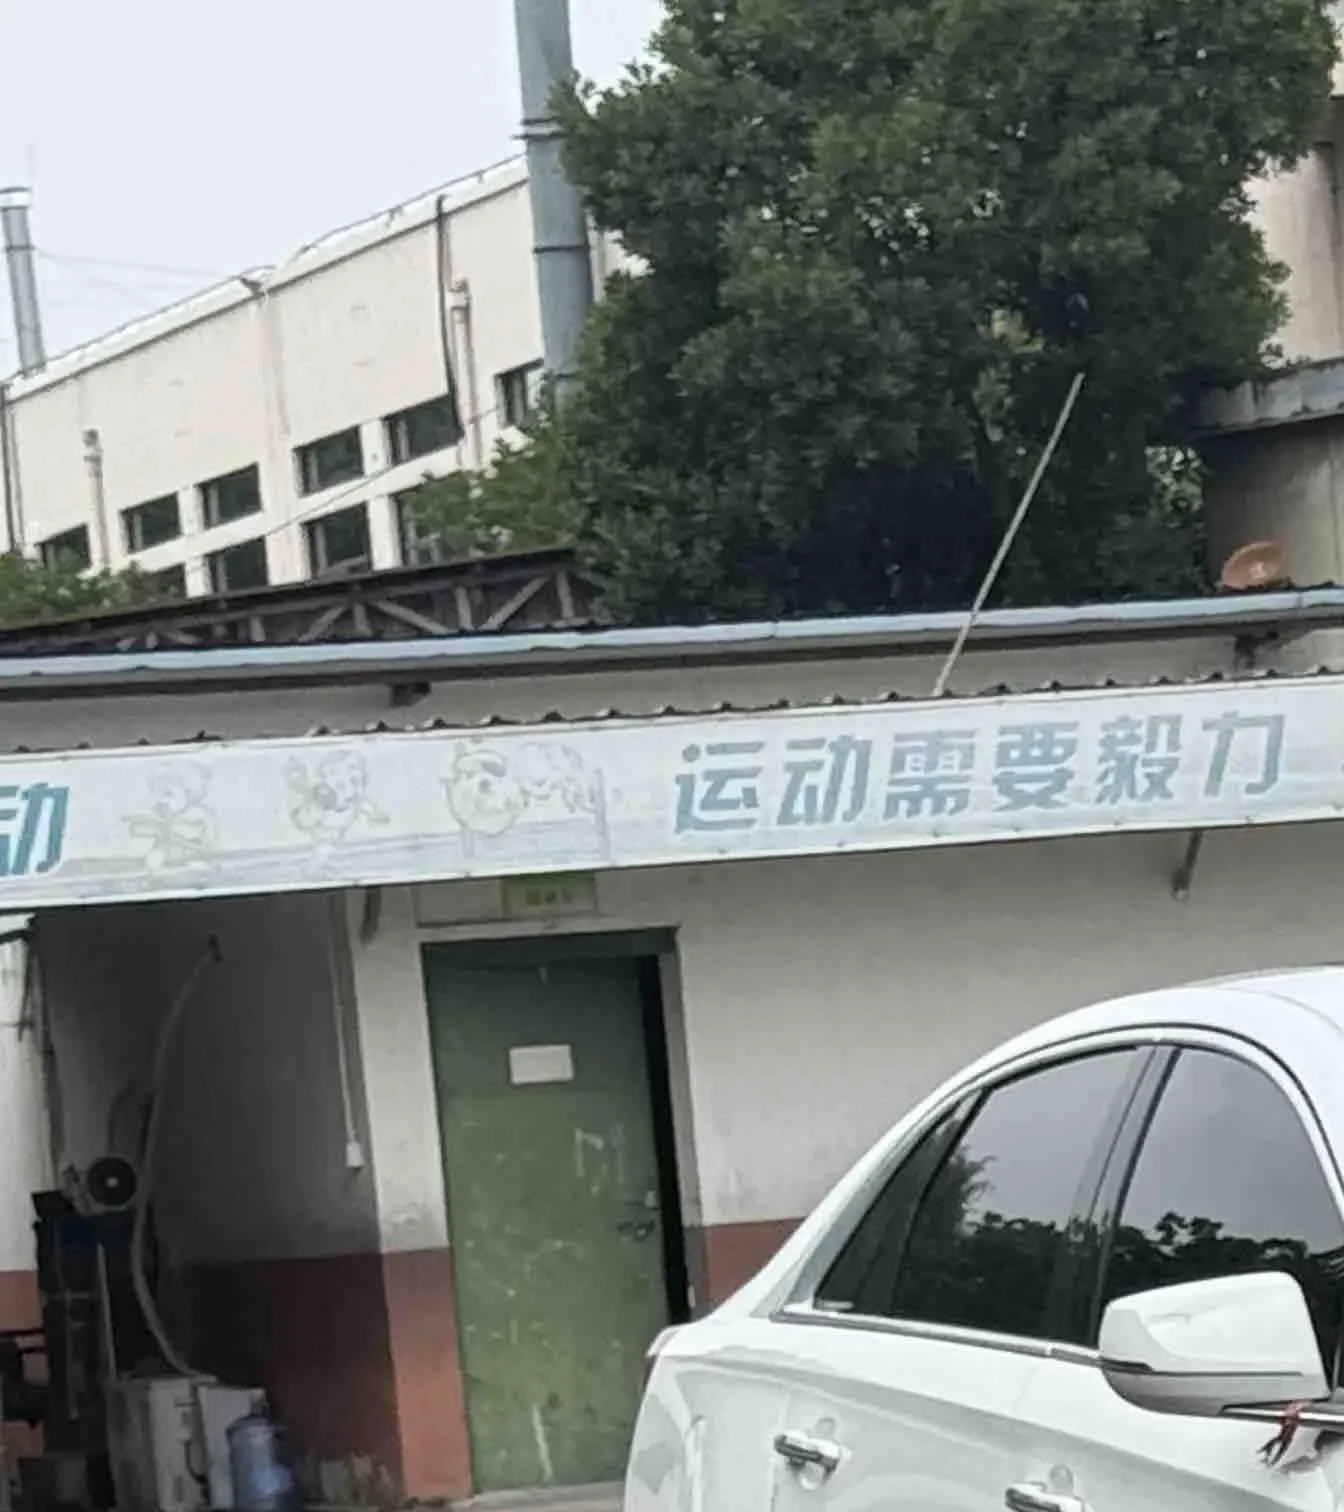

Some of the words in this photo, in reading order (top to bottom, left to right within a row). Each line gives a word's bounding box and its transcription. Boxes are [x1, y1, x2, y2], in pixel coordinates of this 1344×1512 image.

[673, 711, 1286, 835] 运动需要毅力
